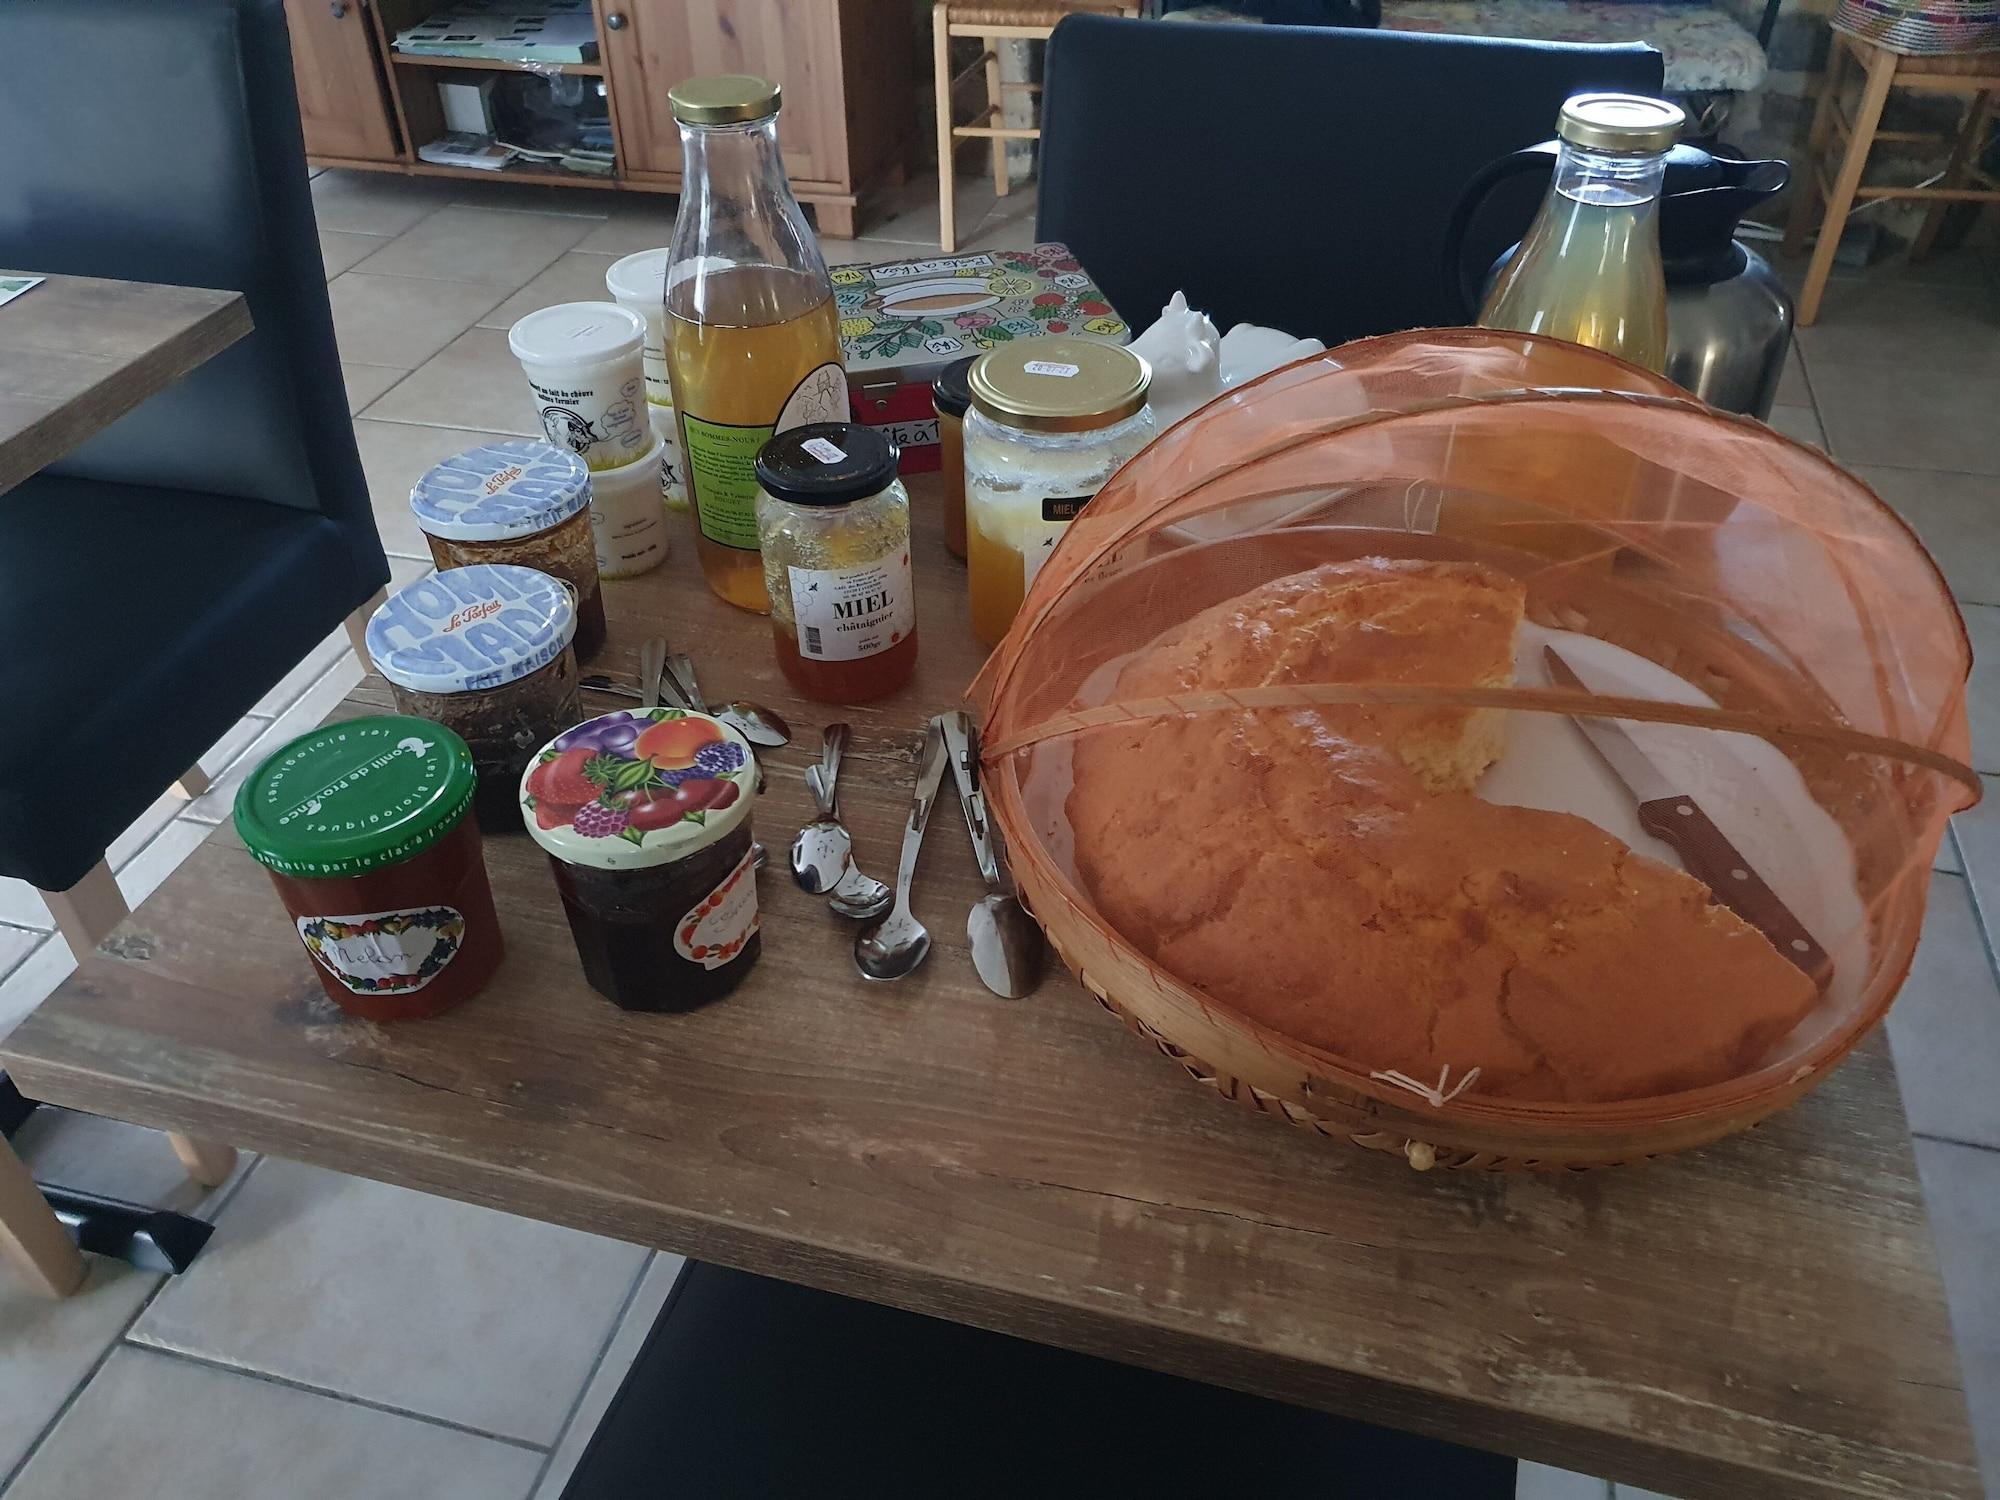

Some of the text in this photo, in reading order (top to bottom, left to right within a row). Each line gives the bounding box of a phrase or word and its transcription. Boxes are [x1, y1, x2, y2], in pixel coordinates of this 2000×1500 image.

[1052, 504, 1077, 516] MIEL
[462, 599, 503, 623] Parfait
[832, 589, 895, 620] MIEL
[836, 610, 894, 633] châtaignier
[511, 633, 566, 679] MAISON
[349, 766, 370, 781] de
[278, 779, 350, 826] Provence
[305, 784, 429, 833] Biologiques
[321, 862, 349, 874] par
[355, 857, 372, 868] le
[379, 843, 411, 862] clac
